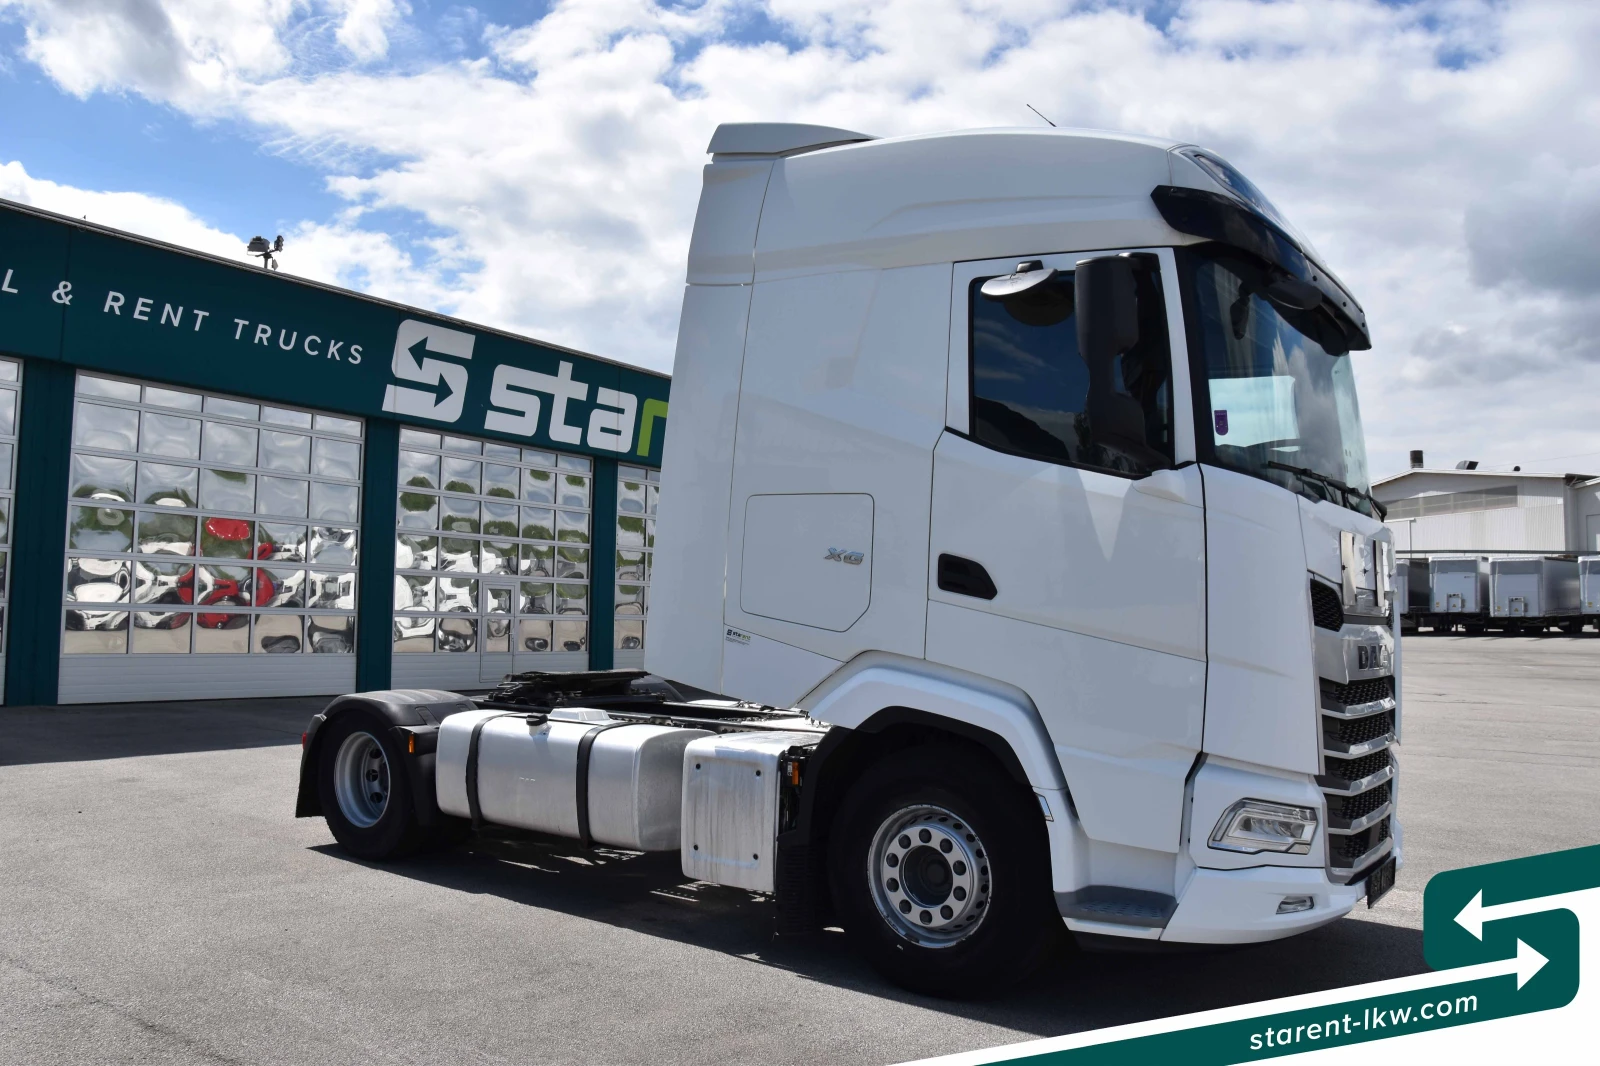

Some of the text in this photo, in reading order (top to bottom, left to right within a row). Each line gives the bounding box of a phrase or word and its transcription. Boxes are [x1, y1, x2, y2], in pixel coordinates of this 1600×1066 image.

[1, 268, 363, 365] L & RENT TRUCKS
[824, 547, 864, 565] XG
